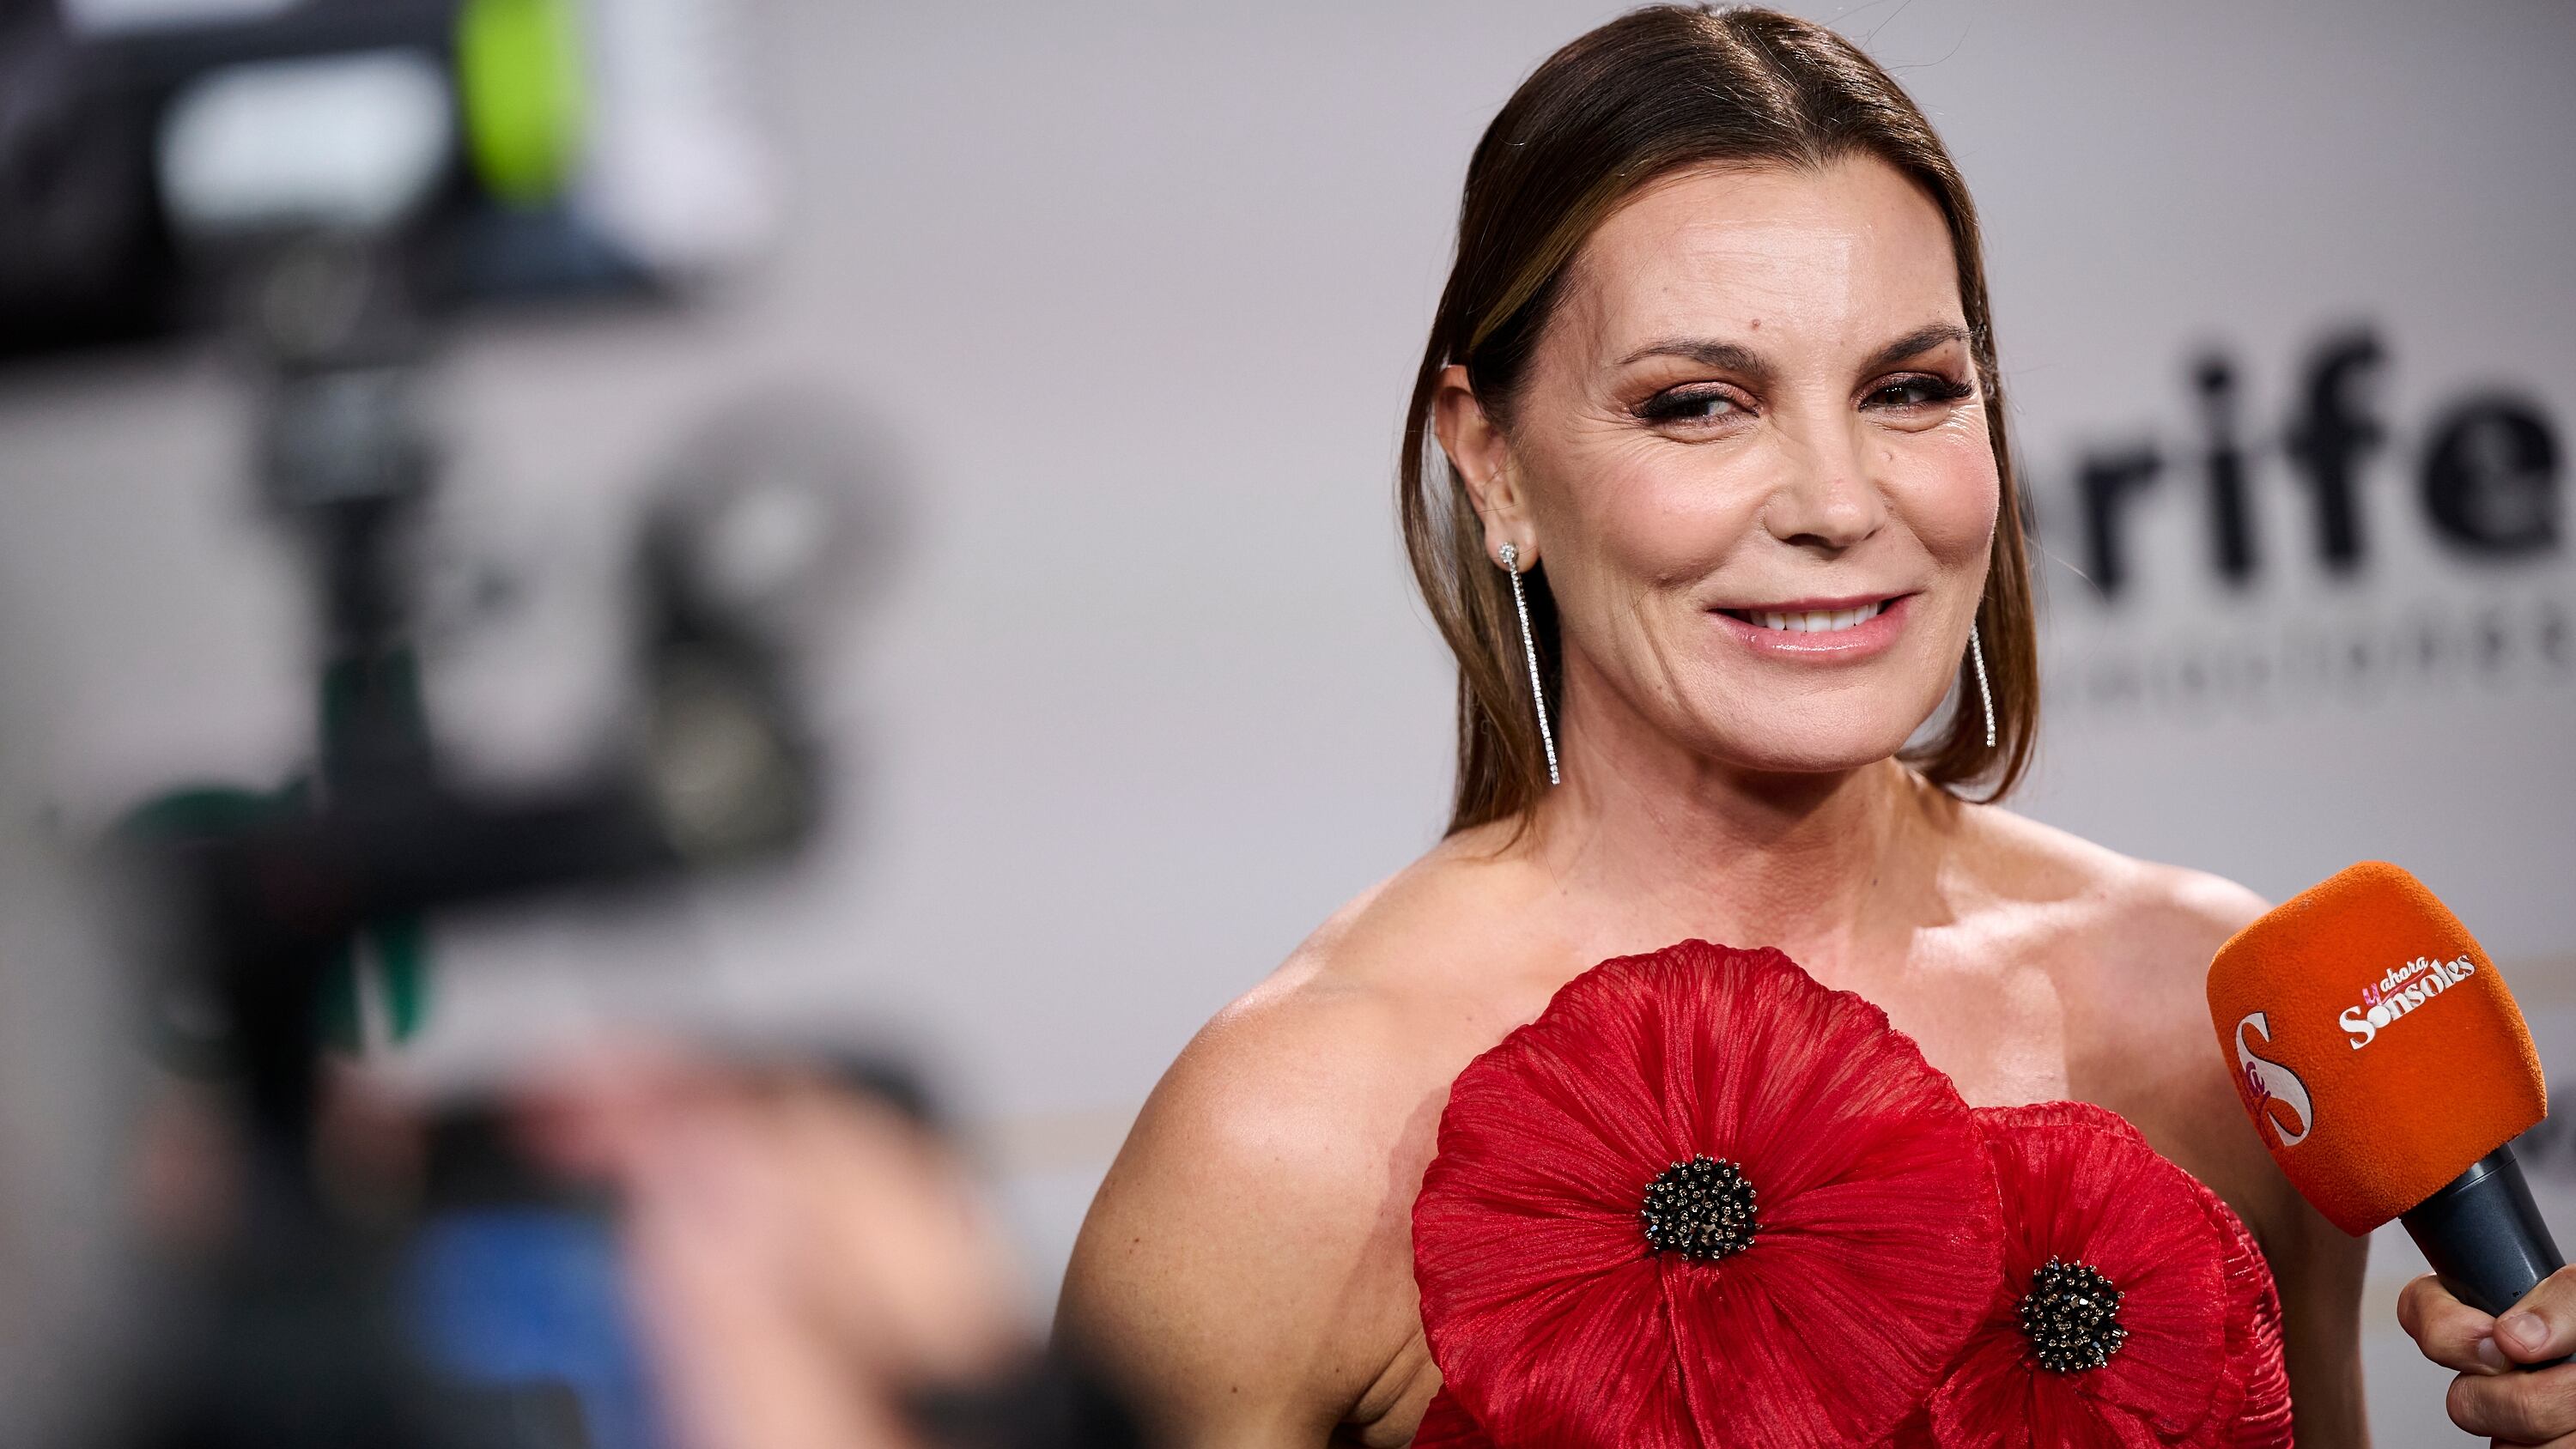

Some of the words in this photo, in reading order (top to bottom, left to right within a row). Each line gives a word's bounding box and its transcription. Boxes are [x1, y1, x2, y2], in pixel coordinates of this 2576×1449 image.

[2033, 321, 2564, 597] rife
[2338, 955, 2476, 1051] Sonsoles
[2379, 956, 2429, 993] ahora
